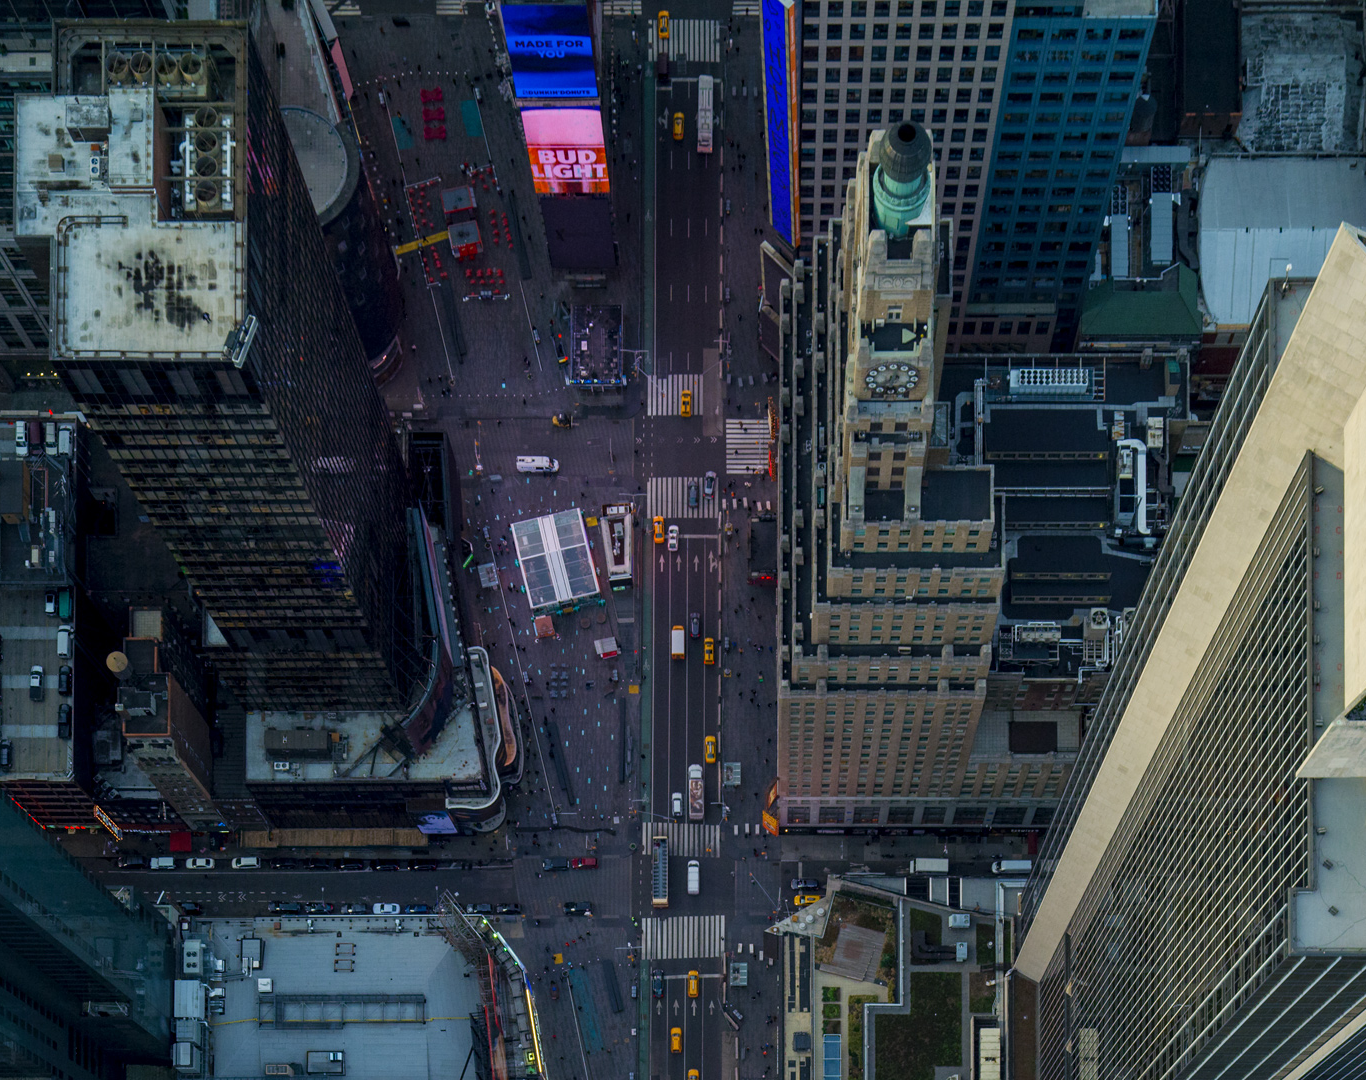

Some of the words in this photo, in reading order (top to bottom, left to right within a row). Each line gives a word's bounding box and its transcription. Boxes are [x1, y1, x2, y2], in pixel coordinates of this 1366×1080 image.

[515, 40, 554, 48] MADE
[557, 40, 584, 48] FOR
[538, 50, 566, 58] YOU
[537, 149, 597, 164] BUD
[531, 164, 607, 179] LIGHT
